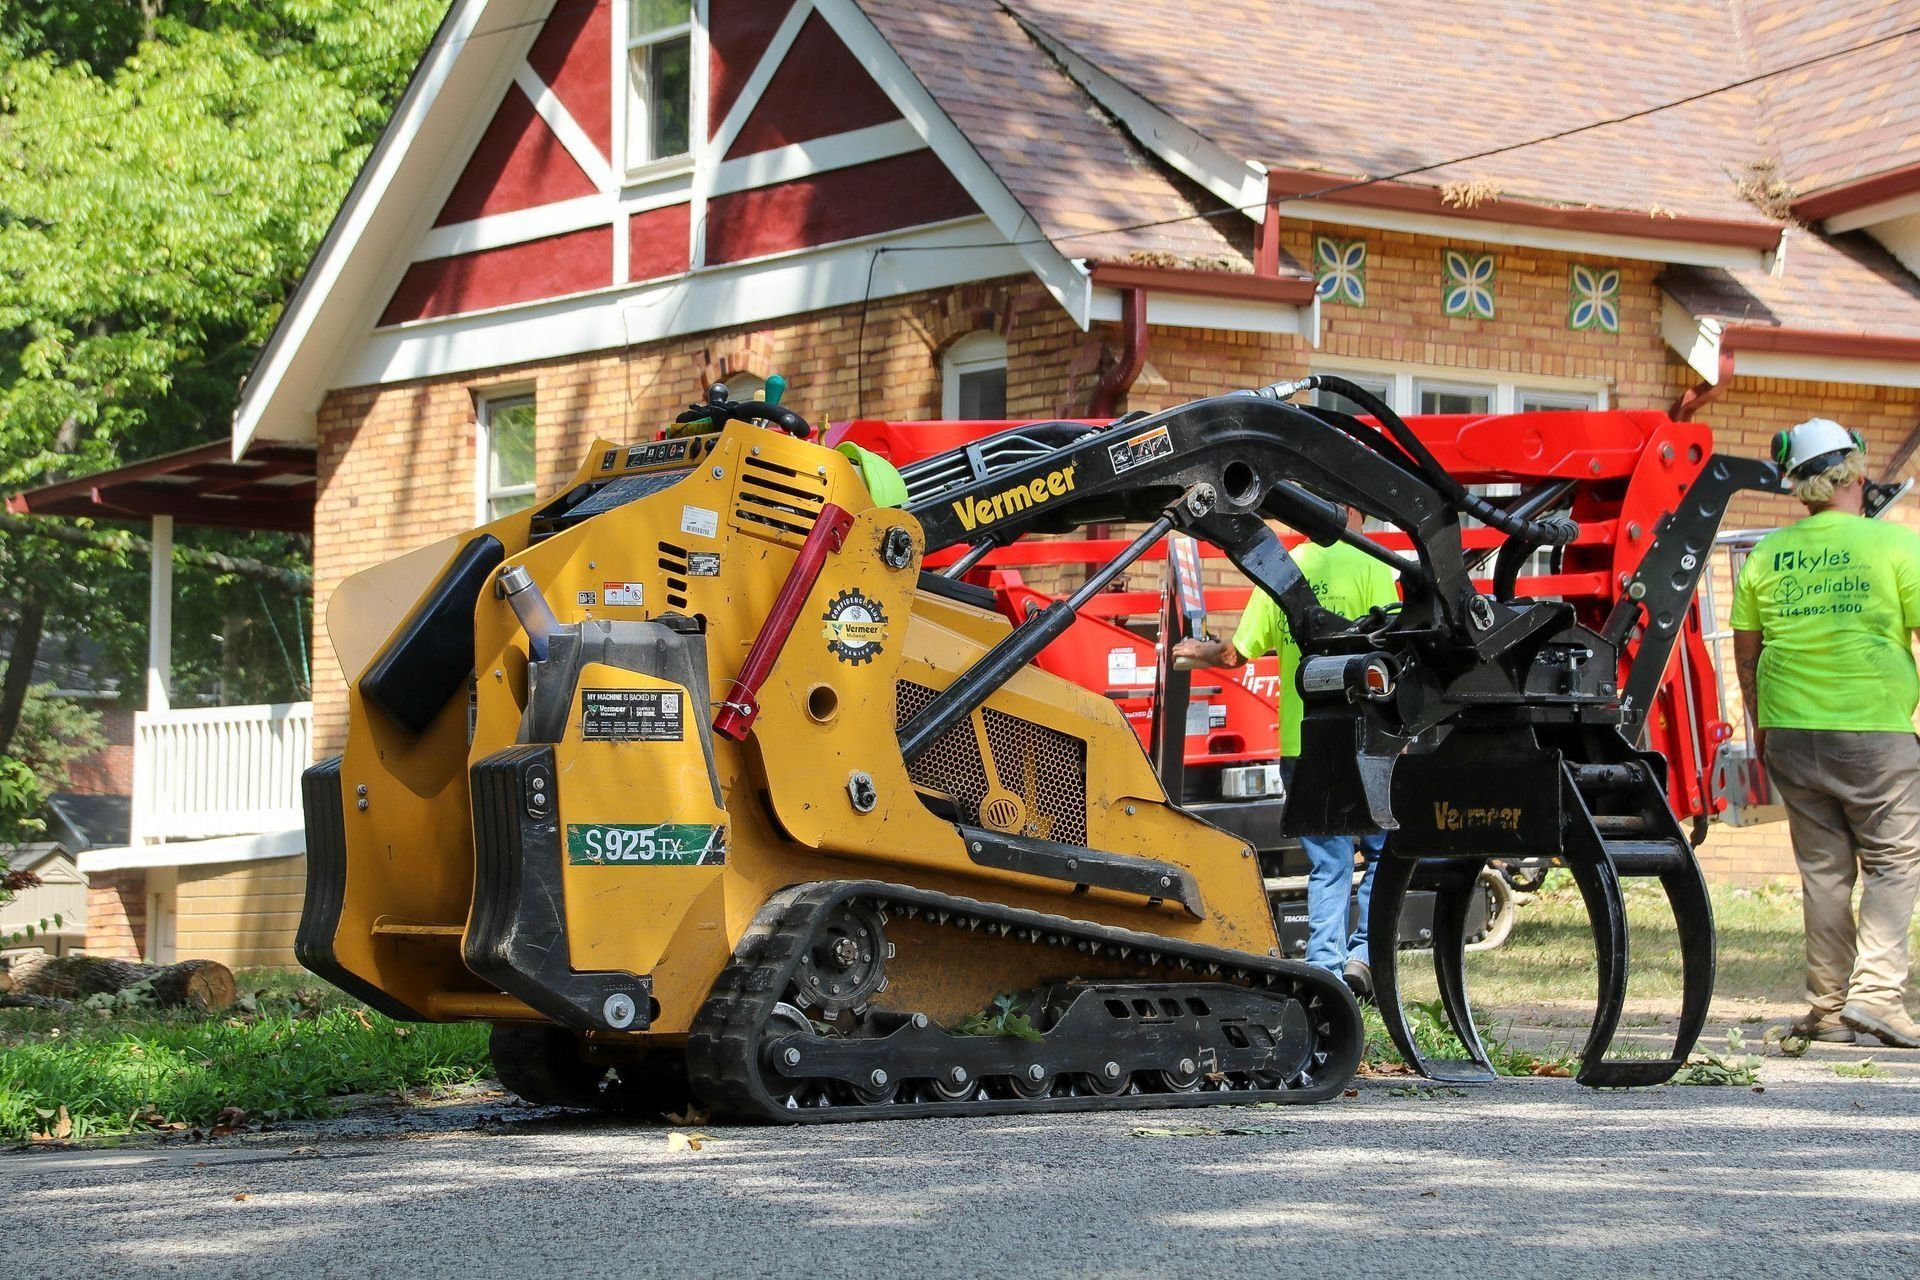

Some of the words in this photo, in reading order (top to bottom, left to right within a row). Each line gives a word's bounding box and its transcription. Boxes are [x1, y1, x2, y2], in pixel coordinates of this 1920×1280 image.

[952, 466, 1075, 531] Vermeer
[1798, 548, 1850, 574] kyle's
[1806, 575, 1870, 595] reliable
[845, 623, 879, 634] Vermeer
[600, 705, 626, 713] Vermeer
